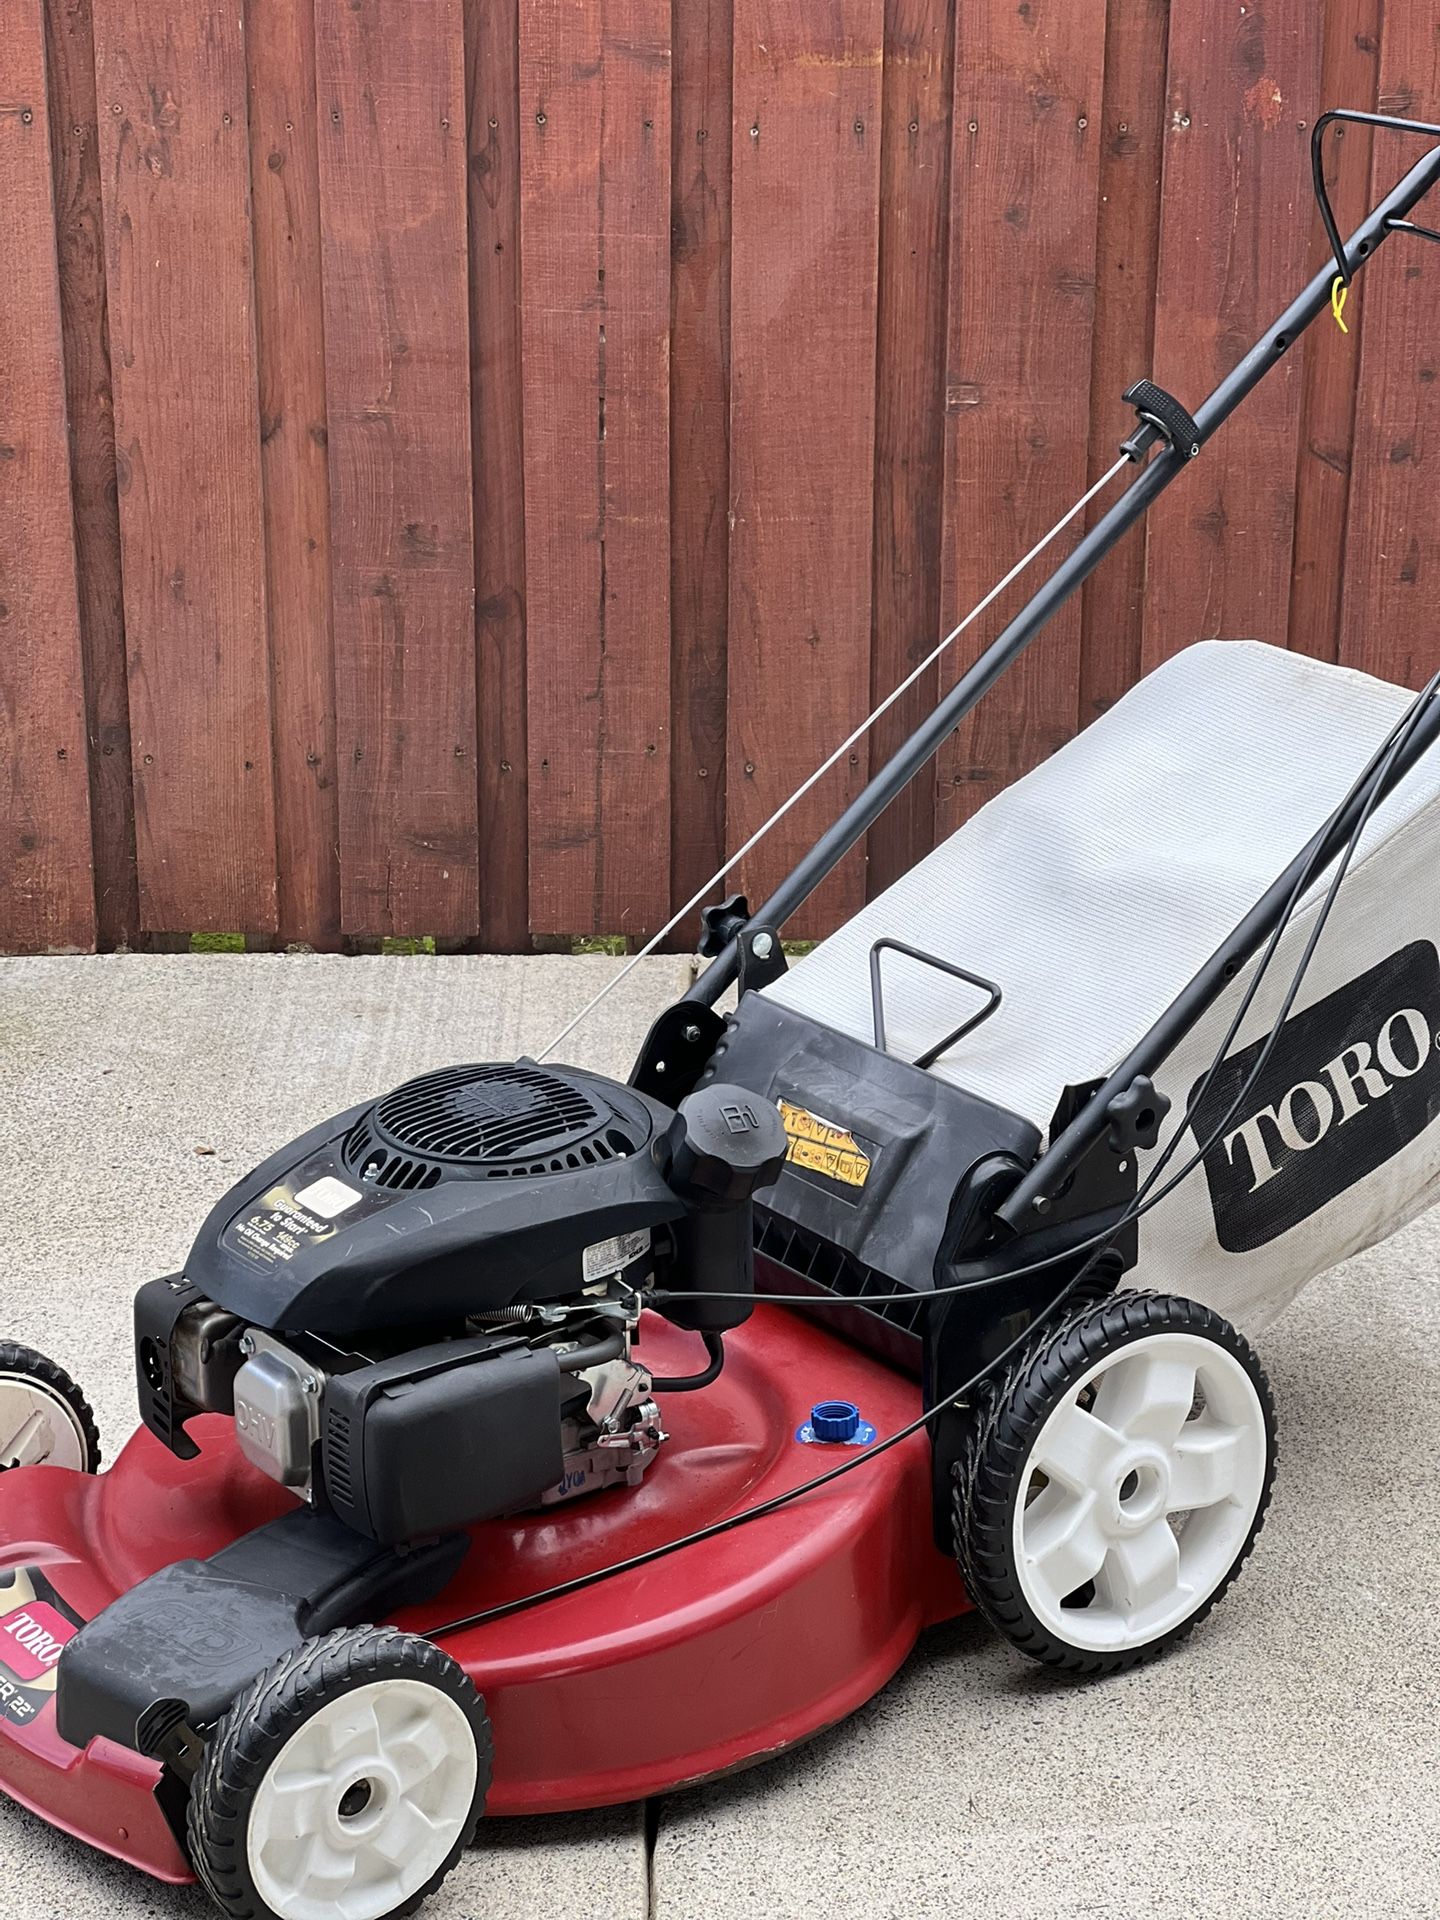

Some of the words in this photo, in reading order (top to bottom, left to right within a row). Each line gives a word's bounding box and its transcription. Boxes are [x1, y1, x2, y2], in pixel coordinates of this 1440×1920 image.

[1222, 1008, 1431, 1194] TORO
[235, 1223, 246, 1233] No
[243, 1227, 254, 1238] Oil
[250, 1215, 275, 1232] 6.75
[276, 1231, 301, 1249] 149cc
[270, 1212, 283, 1222] to
[273, 1198, 329, 1233] Guaranteed
[237, 1400, 275, 1449] OHV
[4, 1611, 64, 1666] TORO
